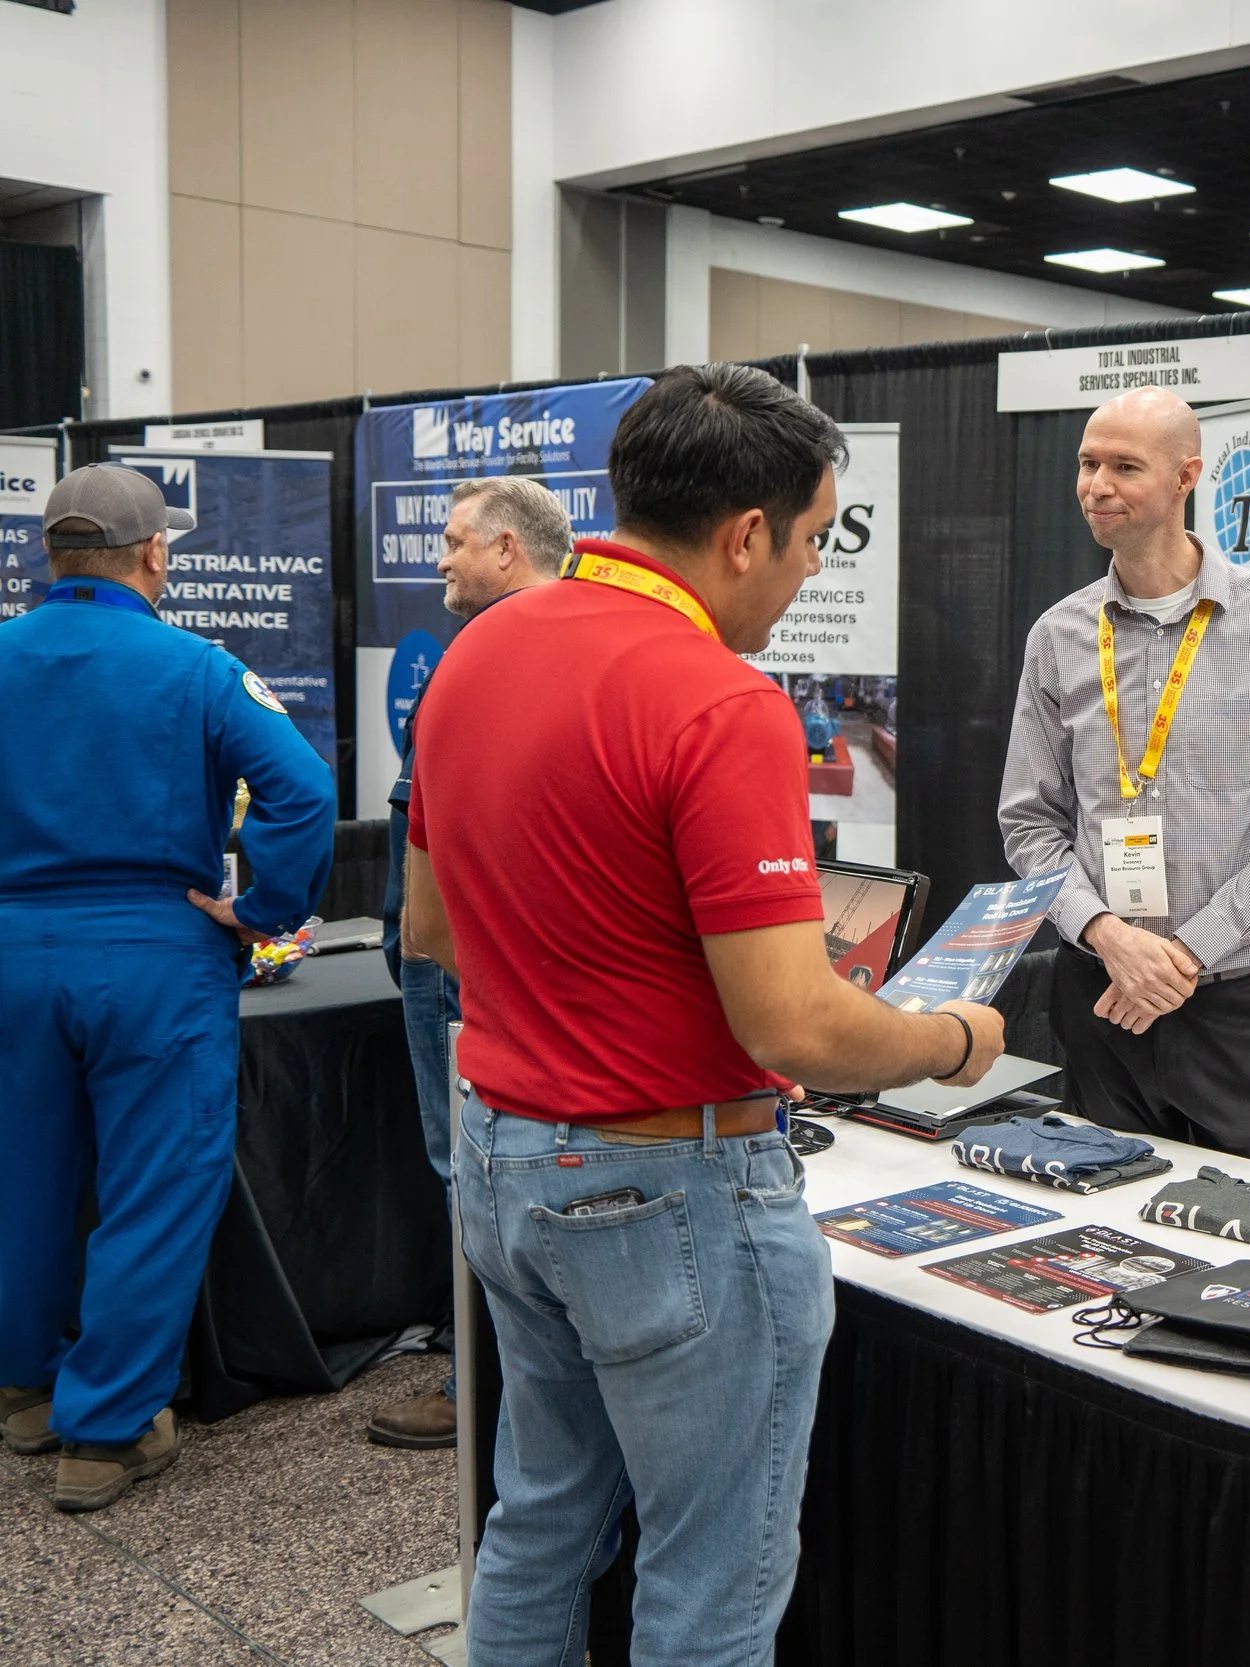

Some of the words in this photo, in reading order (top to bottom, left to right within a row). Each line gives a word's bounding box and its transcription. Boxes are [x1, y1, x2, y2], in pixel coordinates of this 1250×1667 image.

[1098, 351, 1124, 368] TOTAL
[1127, 346, 1180, 366] INDUSTRIAL
[1080, 374, 1119, 392] SERVICES
[1123, 369, 1178, 389] SPECIALTIES
[1182, 367, 1201, 385] INC.
[454, 422, 493, 455] Way
[499, 411, 575, 449] Service
[1210, 443, 1230, 483] Total
[396, 494, 423, 525] WAY
[383, 534, 398, 564] SO
[399, 534, 423, 564] YOU
[6, 553, 19, 568] A
[260, 556, 323, 575] HVAC
[7, 578, 32, 593] OF
[161, 582, 292, 601] VENTATIVE
[780, 630, 849, 643] Extruders
[740, 651, 815, 663] Gearboxes
[758, 858, 790, 874] Only
